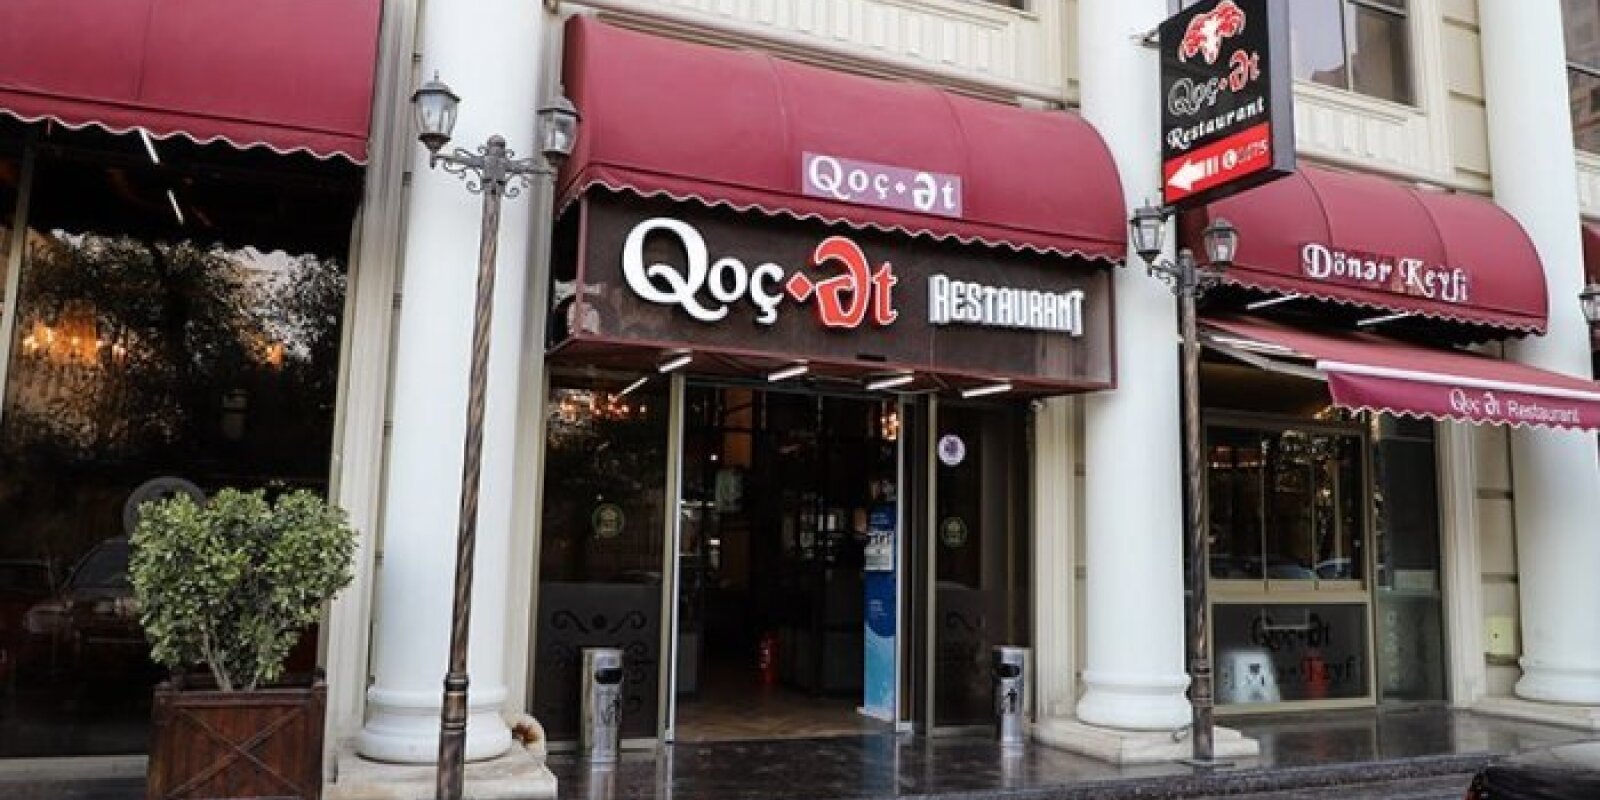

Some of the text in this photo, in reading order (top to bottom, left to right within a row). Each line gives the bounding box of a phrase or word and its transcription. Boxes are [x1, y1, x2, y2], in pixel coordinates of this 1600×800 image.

[1166, 96, 1265, 150] Restaurant
[1399, 258, 1468, 302] Keyfi
[928, 274, 1084, 336] RESTAURANT
[1508, 400, 1580, 423] Restaurant
